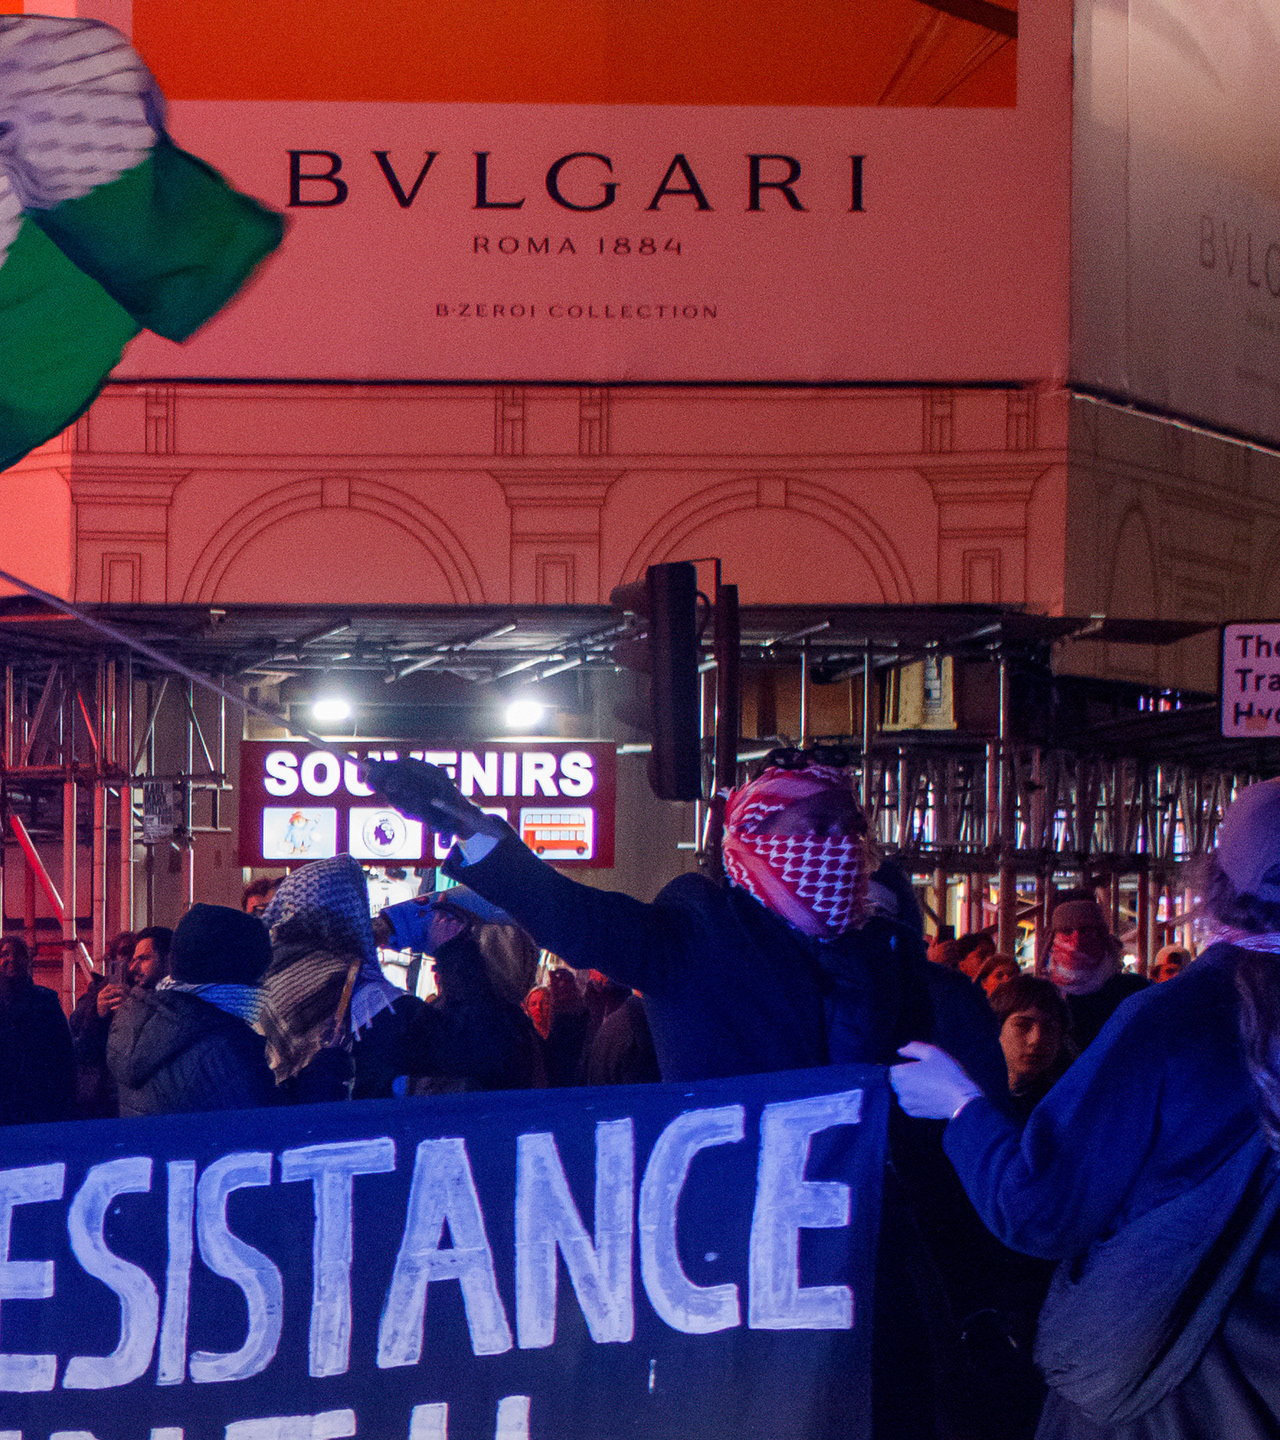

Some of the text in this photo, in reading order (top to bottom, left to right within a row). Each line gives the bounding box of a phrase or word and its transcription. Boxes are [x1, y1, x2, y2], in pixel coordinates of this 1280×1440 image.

[285, 149, 867, 213] BVLGARI
[473, 235, 683, 256] ROMA 1884
[547, 304, 718, 320] COLLECTION
[263, 750, 595, 797] SOUNIRS
